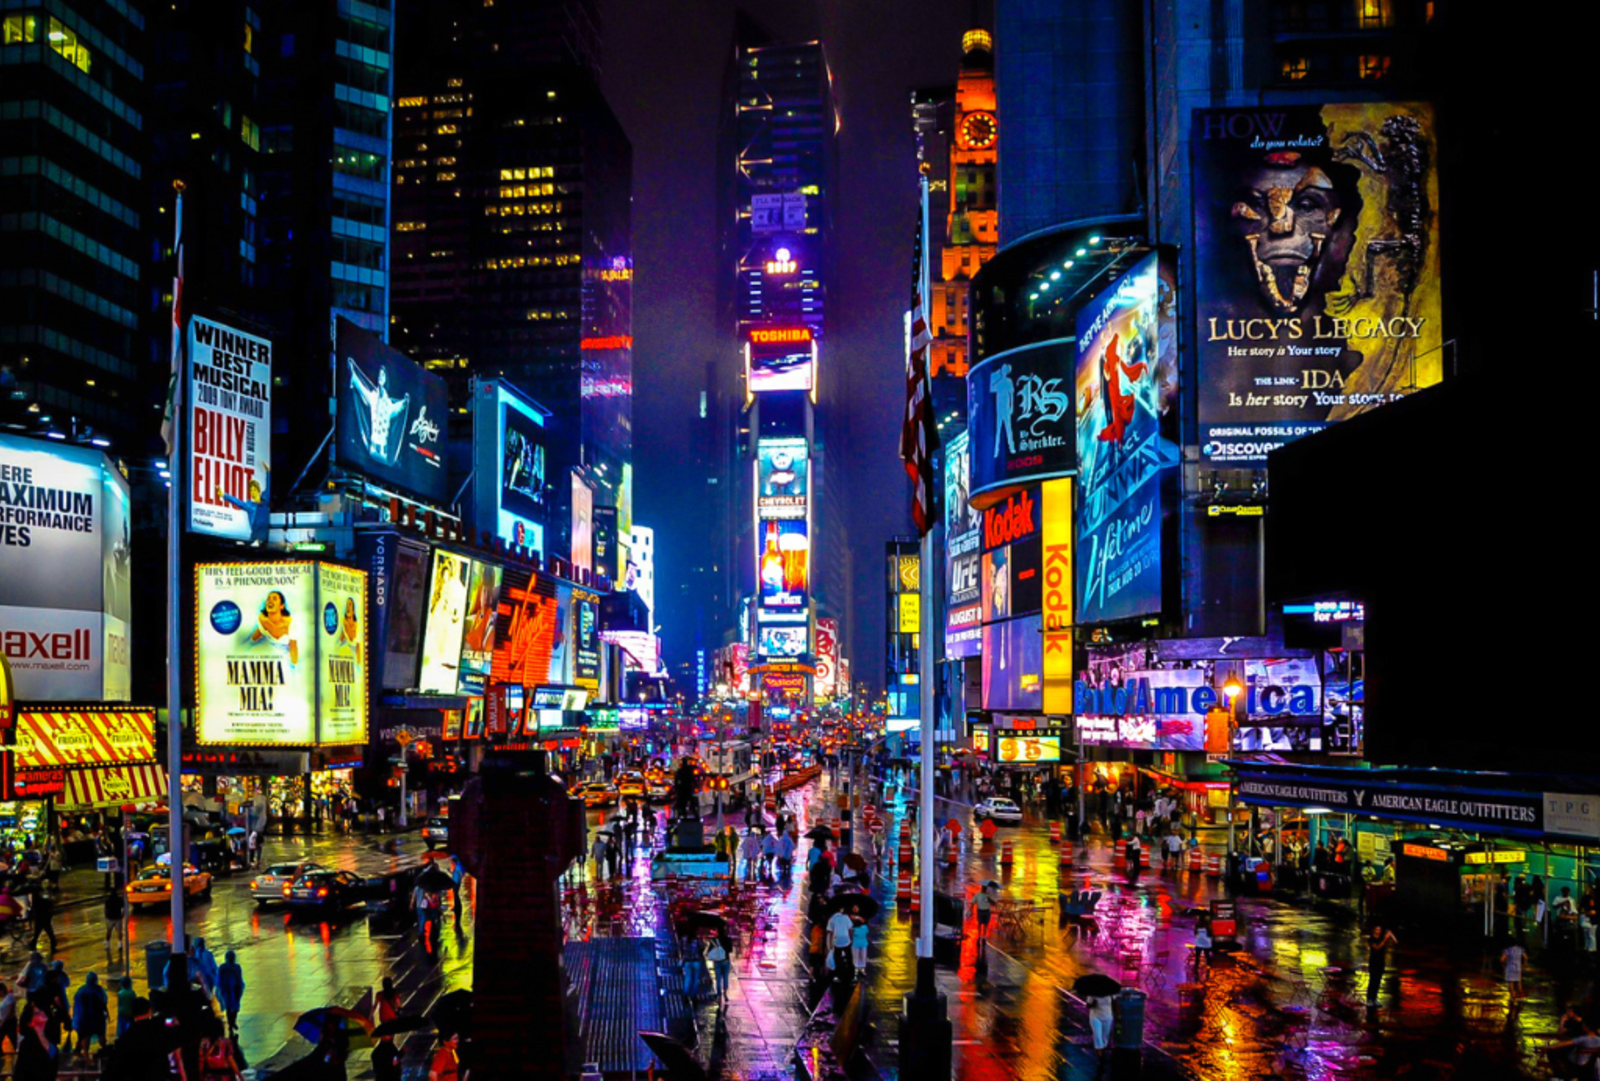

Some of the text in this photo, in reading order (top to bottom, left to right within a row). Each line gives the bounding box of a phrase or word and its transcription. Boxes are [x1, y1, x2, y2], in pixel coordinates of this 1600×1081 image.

[1202, 114, 1286, 140] HOW
[1250, 134, 1324, 151] do you relate?
[751, 330, 810, 342] TOSHIBA
[1208, 315, 1425, 342] LUCY'S LEGACY
[193, 320, 269, 366] WINNER
[1228, 345, 1342, 358] Her story is Your story
[212, 349, 253, 378] BEST
[193, 361, 269, 402] MUSICAL
[1253, 377, 1271, 387] THE
[1301, 370, 1347, 390] IDA
[1228, 392, 1244, 407] Is
[1246, 391, 1271, 407] her
[1274, 393, 1308, 409] story
[1313, 391, 1345, 405] Your
[194, 406, 246, 463] BILLY
[1209, 427, 1254, 438] ORIGINAL
[1254, 426, 1294, 437] FOSSILS
[1295, 426, 1308, 436] OF
[1209, 441, 1284, 455] DISCOVE
[0, 464, 32, 484] ERE
[194, 455, 255, 511] ELLIOT
[984, 490, 1034, 550] Kodak
[215, 577, 224, 586] IS
[225, 577, 232, 585] A
[376, 535, 384, 606] VORNADO
[952, 555, 977, 592] UFC
[1045, 543, 1068, 654] Kodak
[0, 628, 91, 661] axell
[10, 662, 90, 672] www.maxell.com
[227, 661, 286, 686] MAMMA
[240, 687, 274, 711] MIA!
[1135, 677, 1317, 716] Ameica
[1239, 782, 1349, 804] AMERICAN EAGLE OUTFITTERS
[1371, 793, 1537, 822] AMERICAN EAGLE OUTFITTERS
